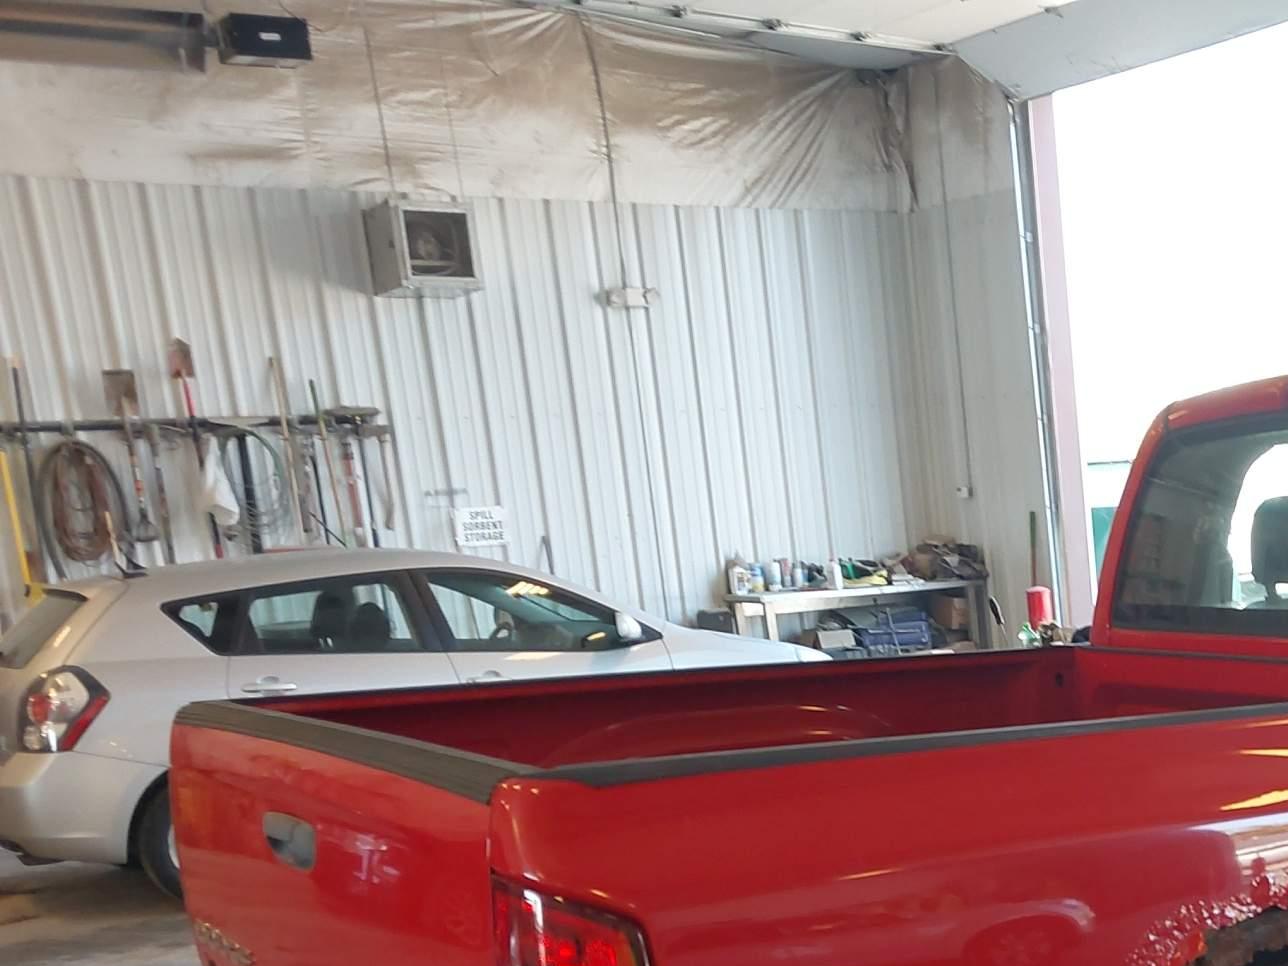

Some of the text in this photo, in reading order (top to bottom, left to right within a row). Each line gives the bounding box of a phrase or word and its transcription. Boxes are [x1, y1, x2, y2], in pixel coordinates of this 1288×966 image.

[469, 510, 494, 520] SPILL
[463, 520, 504, 532] SORBENT
[464, 531, 505, 542] STORAGE
